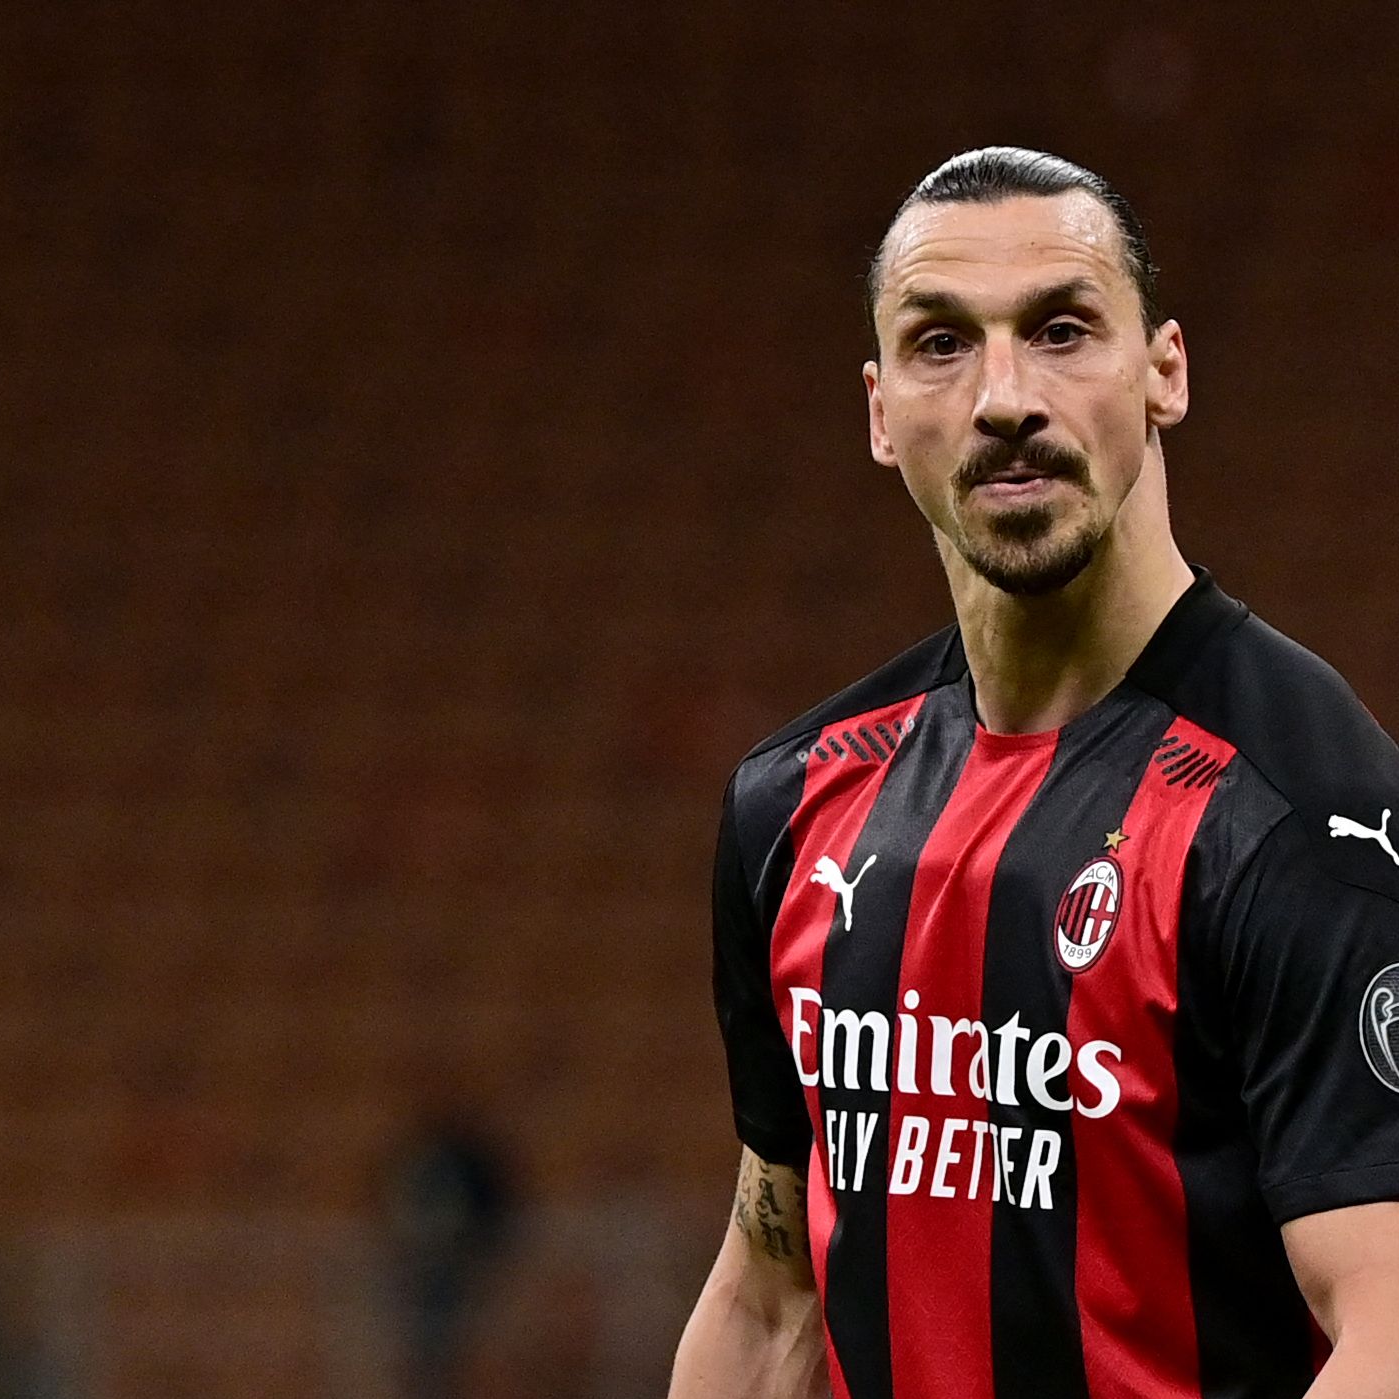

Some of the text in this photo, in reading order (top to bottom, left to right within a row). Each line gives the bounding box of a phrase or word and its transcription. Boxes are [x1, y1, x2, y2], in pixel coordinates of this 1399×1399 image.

[1080, 865, 1115, 888] ACM
[1063, 943, 1092, 960] 1899
[789, 986, 1122, 1119] Emirates
[826, 1109, 879, 1192] FLY
[889, 1114, 1062, 1210] BETTER
